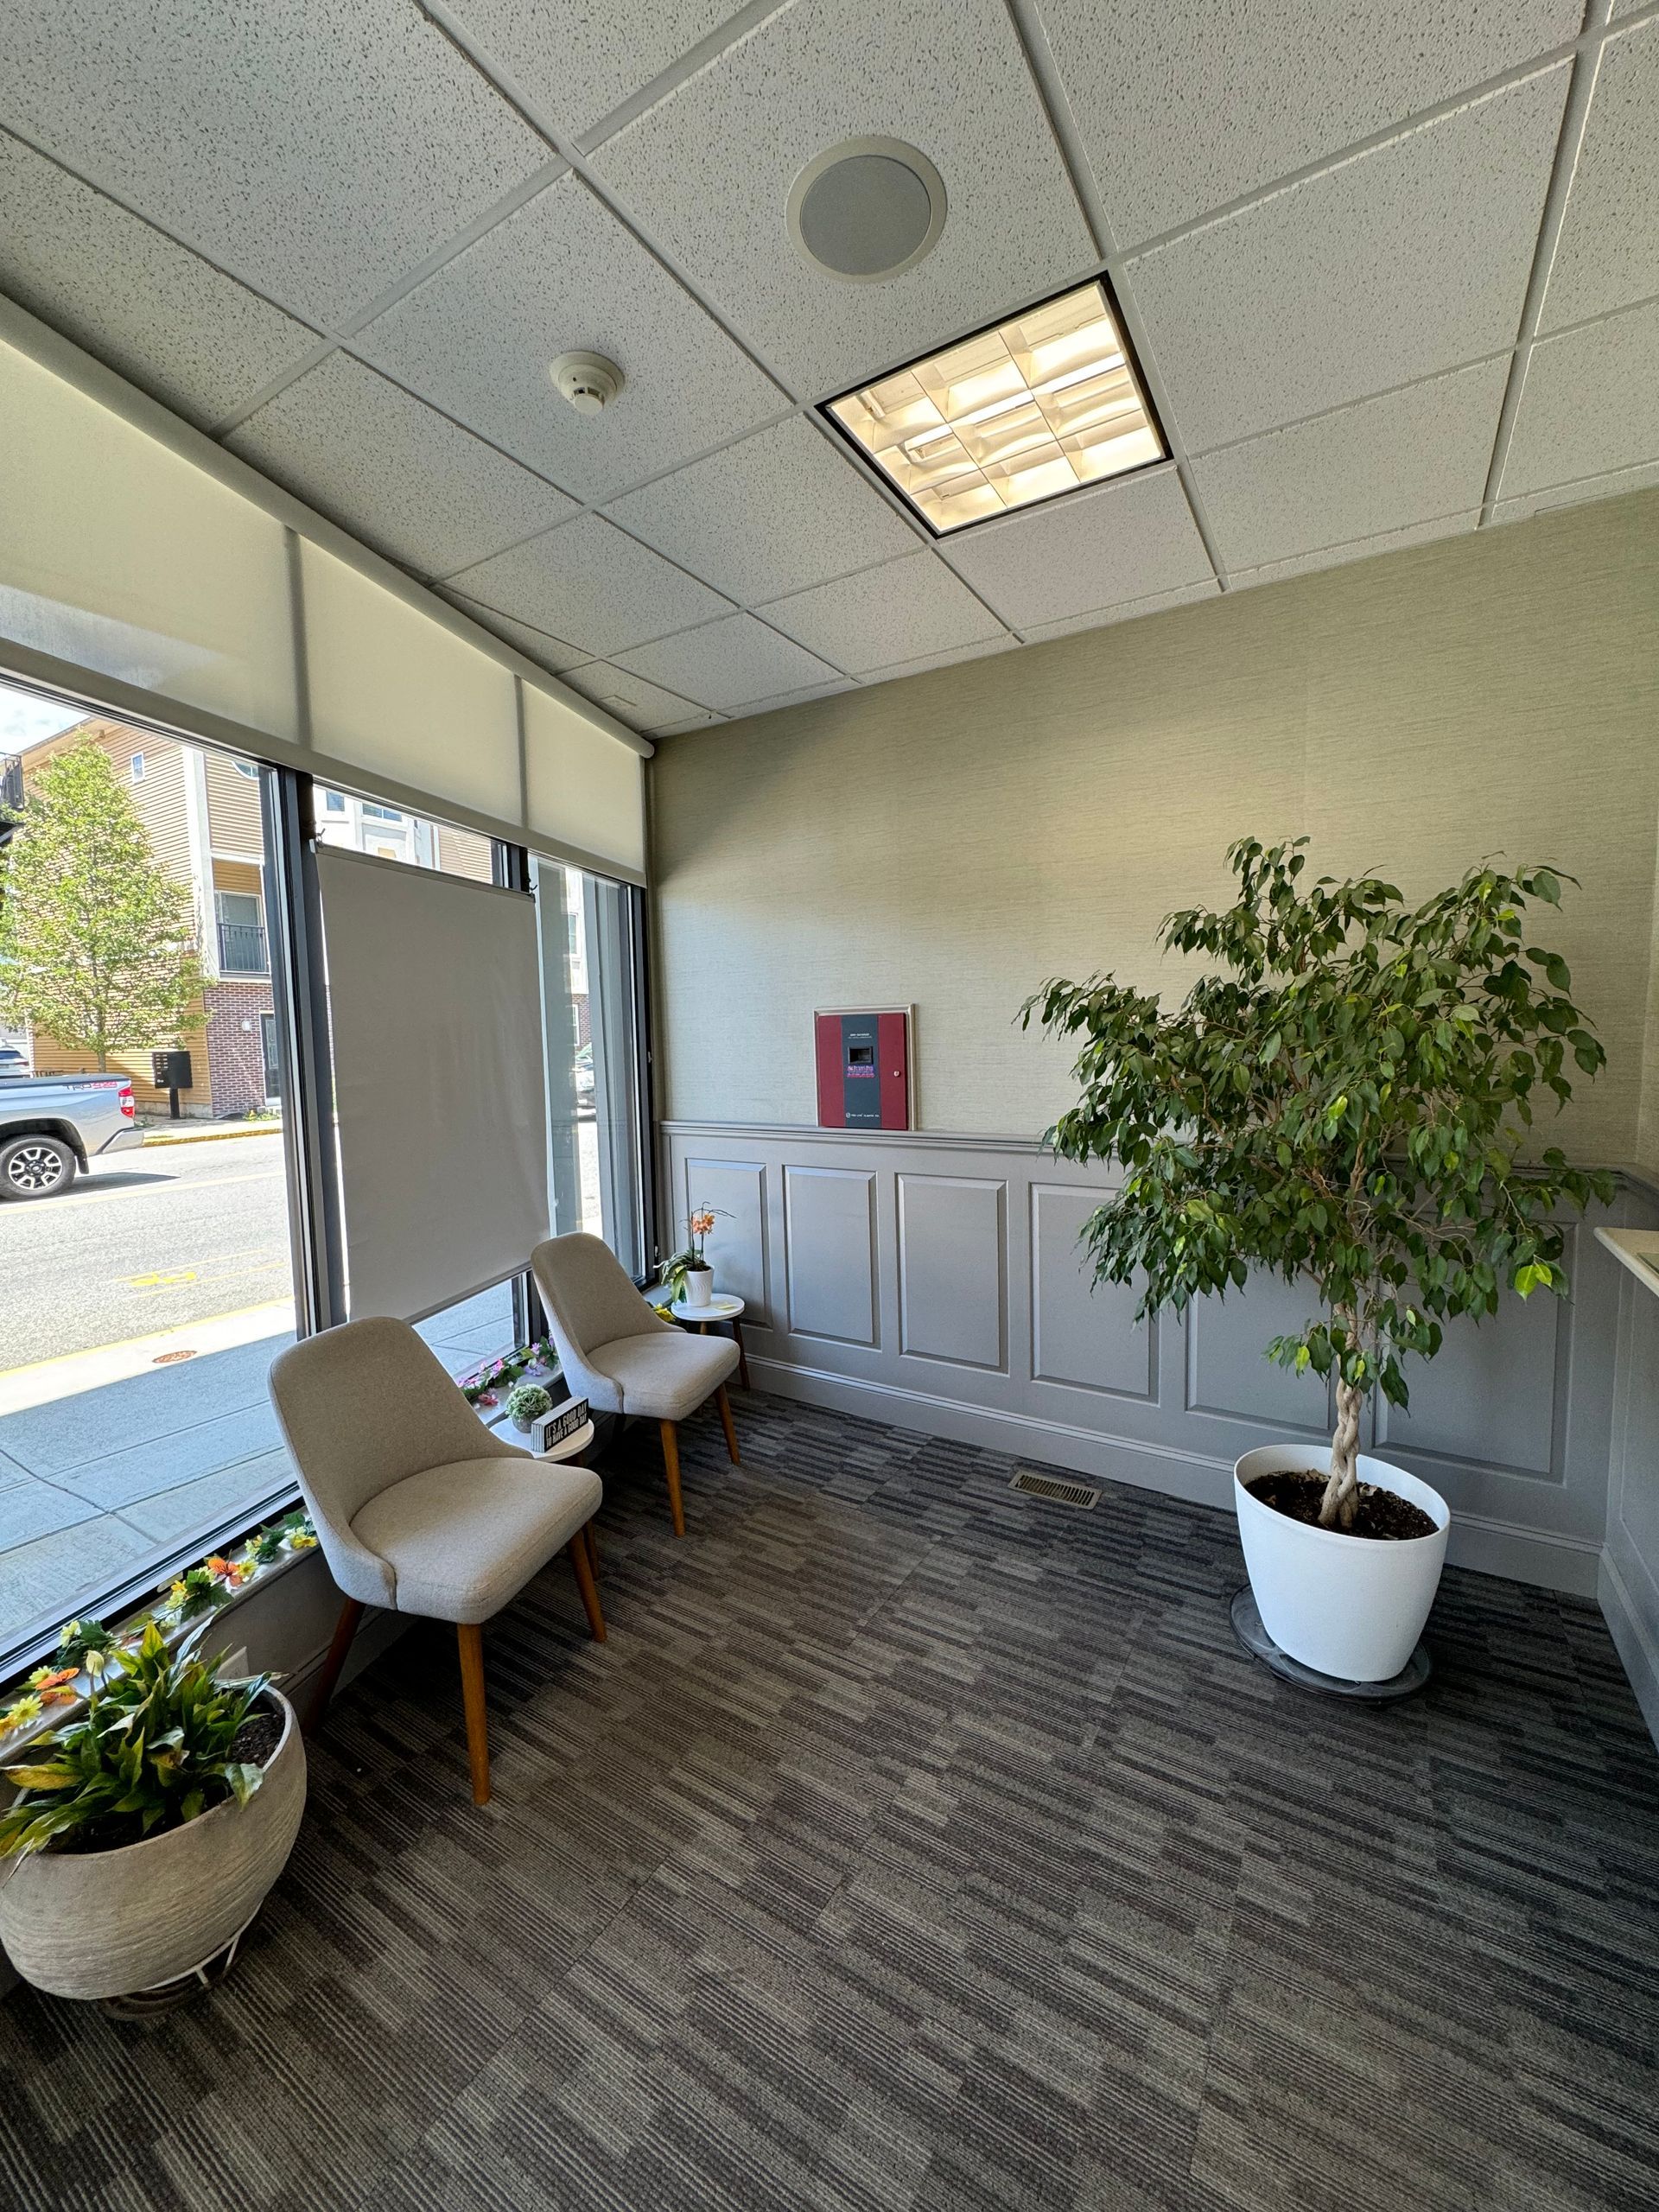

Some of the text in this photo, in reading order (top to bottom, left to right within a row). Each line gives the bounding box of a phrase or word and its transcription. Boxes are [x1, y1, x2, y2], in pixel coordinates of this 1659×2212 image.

[546, 1402, 587, 1439] IT'S A GOOD DAY
[546, 1436, 552, 1448] TO
[553, 1428, 563, 1444] HAVE
[563, 1426, 568, 1436] A
[568, 1418, 579, 1433] GOOD
